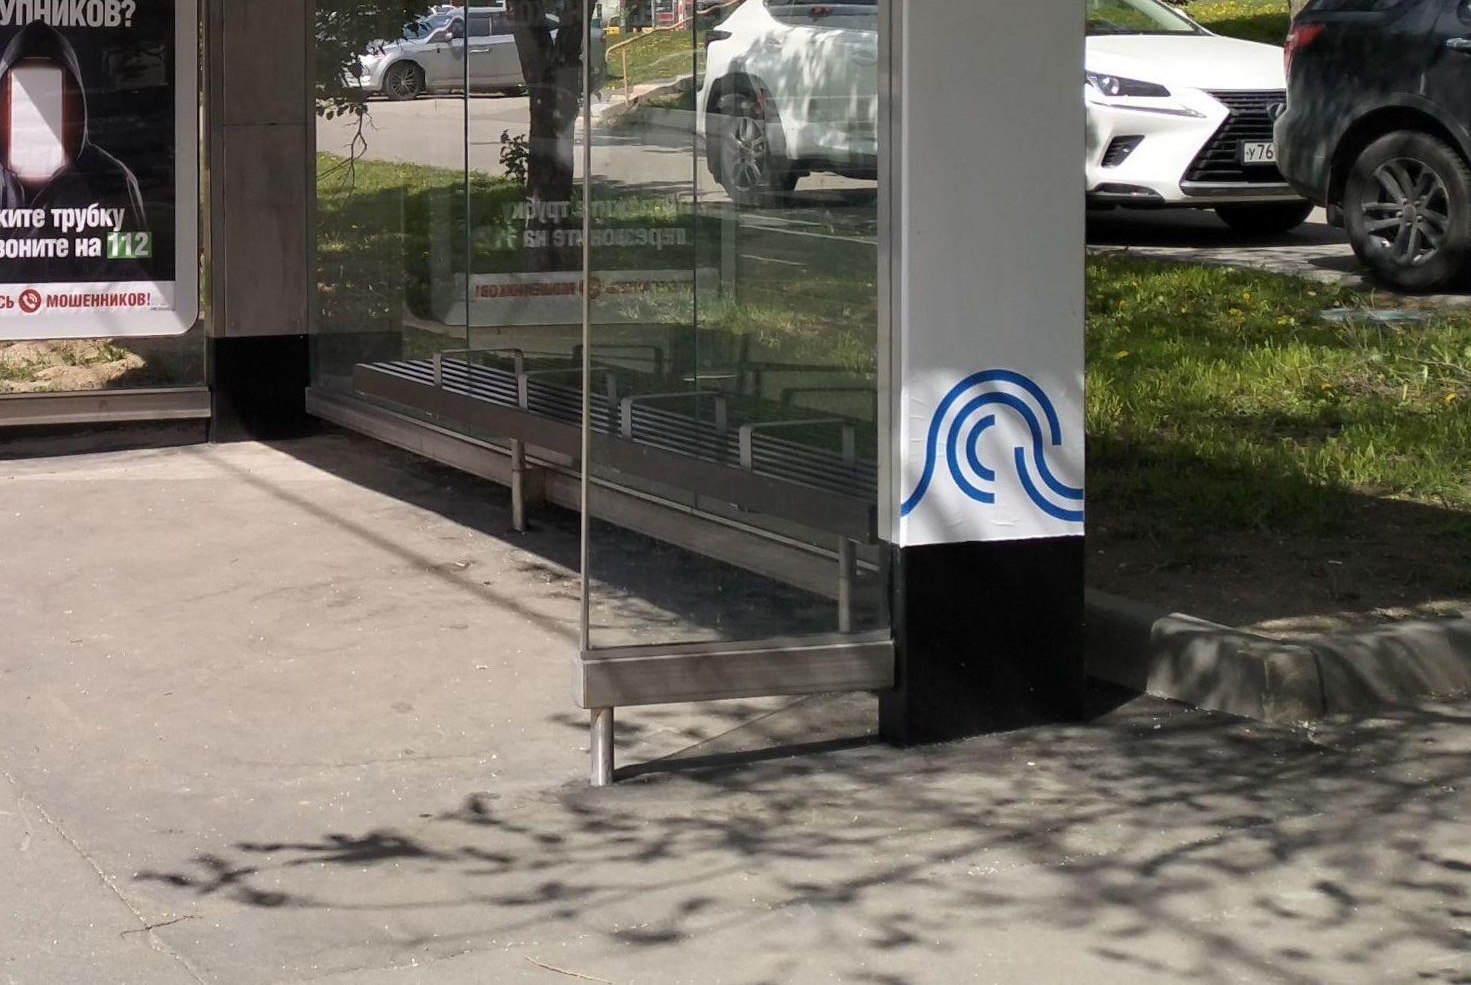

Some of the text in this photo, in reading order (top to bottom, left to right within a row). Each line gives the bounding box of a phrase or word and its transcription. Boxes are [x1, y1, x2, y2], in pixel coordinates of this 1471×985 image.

[51, 203, 125, 233] трубку
[75, 237, 102, 257] на
[108, 232, 149, 257] 112
[46, 291, 151, 308] МОШЕННИКОВ!
